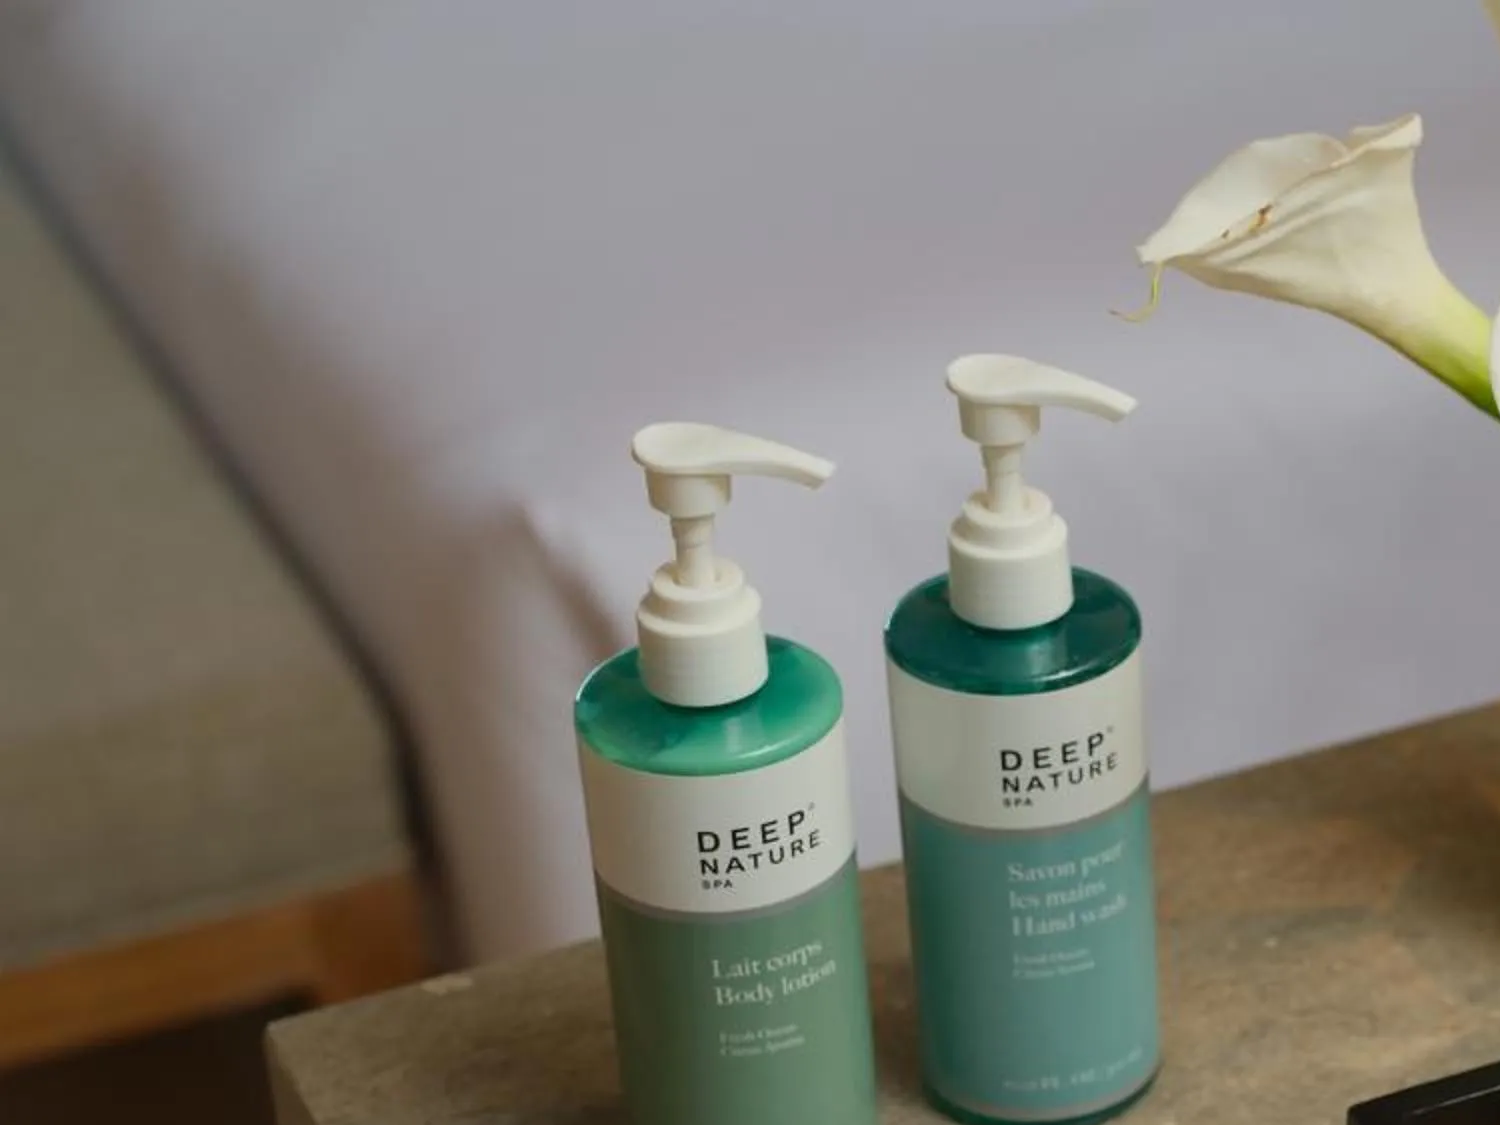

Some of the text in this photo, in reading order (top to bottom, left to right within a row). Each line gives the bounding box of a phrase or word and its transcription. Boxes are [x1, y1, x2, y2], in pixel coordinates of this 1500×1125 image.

[1000, 732, 1105, 772] DEEP
[1001, 752, 1119, 793] NATURE
[1002, 797, 1034, 808] SPA
[697, 809, 806, 853] DEEP
[700, 828, 821, 875] NATURE
[701, 879, 733, 890] SPA
[712, 941, 823, 979] Lait corps
[714, 959, 836, 1007] Body lotion
